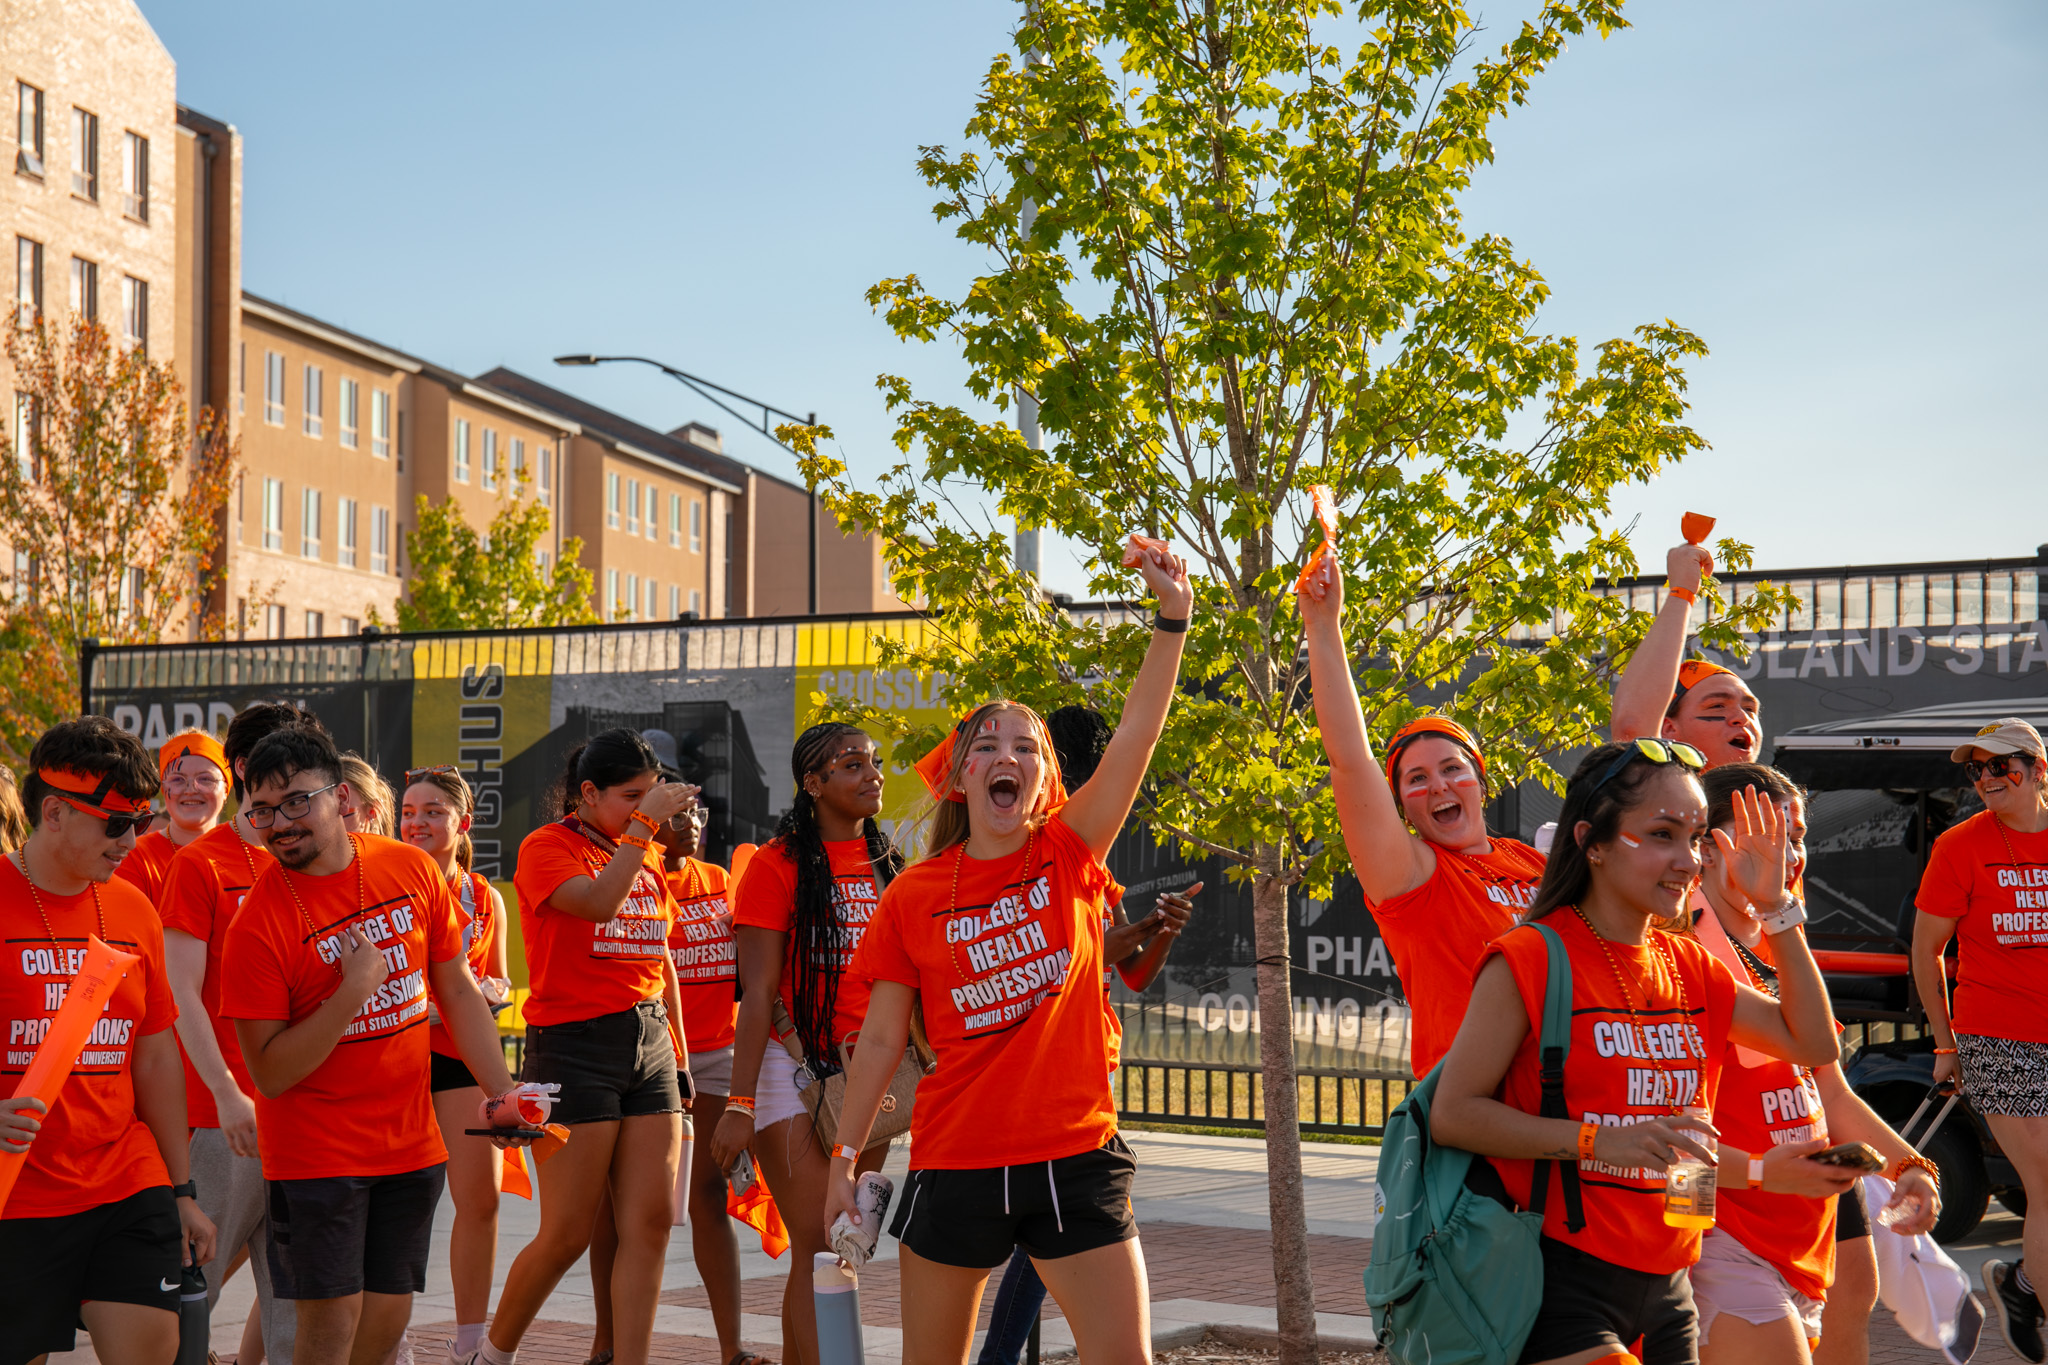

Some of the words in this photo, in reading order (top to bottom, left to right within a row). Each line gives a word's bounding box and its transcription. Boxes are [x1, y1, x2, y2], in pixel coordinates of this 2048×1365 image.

[818, 668, 962, 709] CROSSLA
[114, 700, 306, 750] PARD
[1156, 870, 1197, 890] STADIUM
[390, 905, 414, 935] OF
[946, 895, 1029, 944] COLLEGE
[1028, 876, 1051, 911] OF
[593, 941, 622, 954] WICHITA
[623, 943, 641, 954] STATE
[966, 920, 1048, 974] HEALTH
[1307, 936, 1398, 976] PHA
[1996, 934, 2030, 945] WICHITA
[697, 966, 717, 977] STATE
[950, 947, 1072, 1013] PROFESSION
[368, 1012, 399, 1032] STATE
[964, 1009, 1002, 1031] WICHITA
[1004, 999, 1032, 1021] STATE
[1198, 993, 1361, 1038] COING
[82, 1050, 127, 1066] UNIVERSITY
[1593, 1021, 1687, 1060] COLLEGE
[1627, 1068, 1698, 1107] HEALTH
